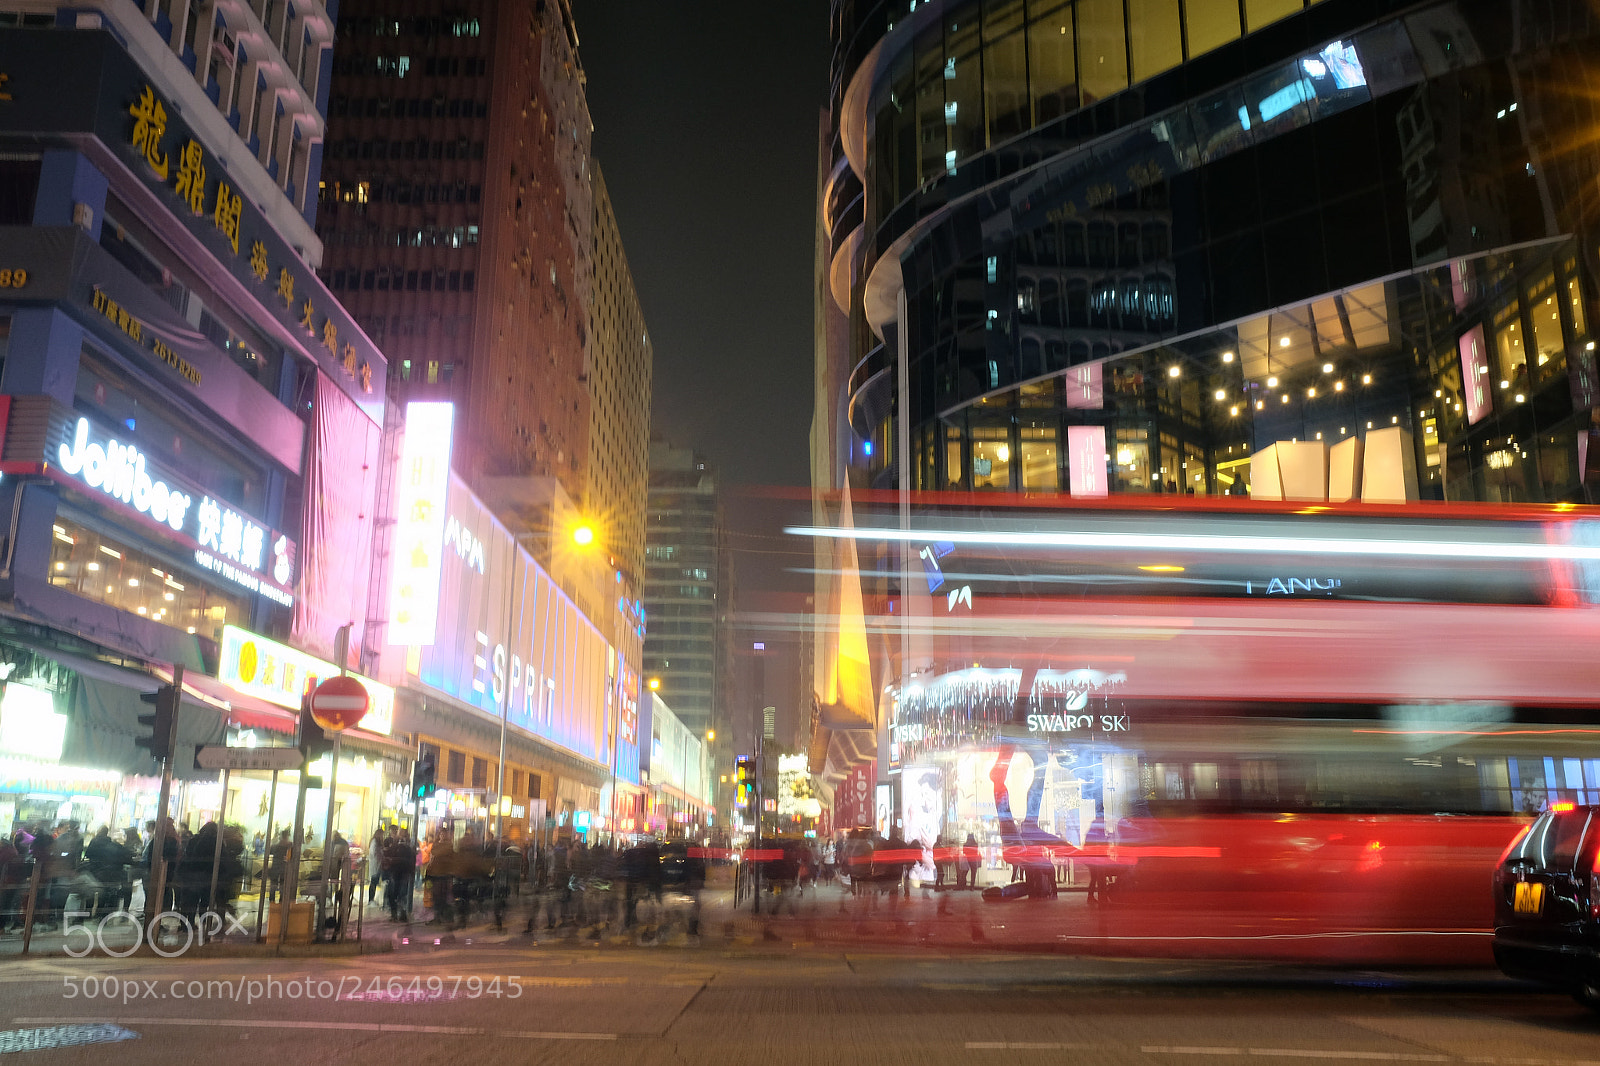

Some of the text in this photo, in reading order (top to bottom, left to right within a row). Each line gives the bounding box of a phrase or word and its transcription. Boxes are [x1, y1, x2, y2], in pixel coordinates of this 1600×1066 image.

[129, 84, 242, 255] 龍鼎閣
[153, 338, 179, 369] 2613
[178, 358, 202, 387] 8289
[59, 417, 191, 531] Jollibee
[473, 630, 556, 727] ESPRIT
[1026, 714, 1130, 732] SWAROSK
